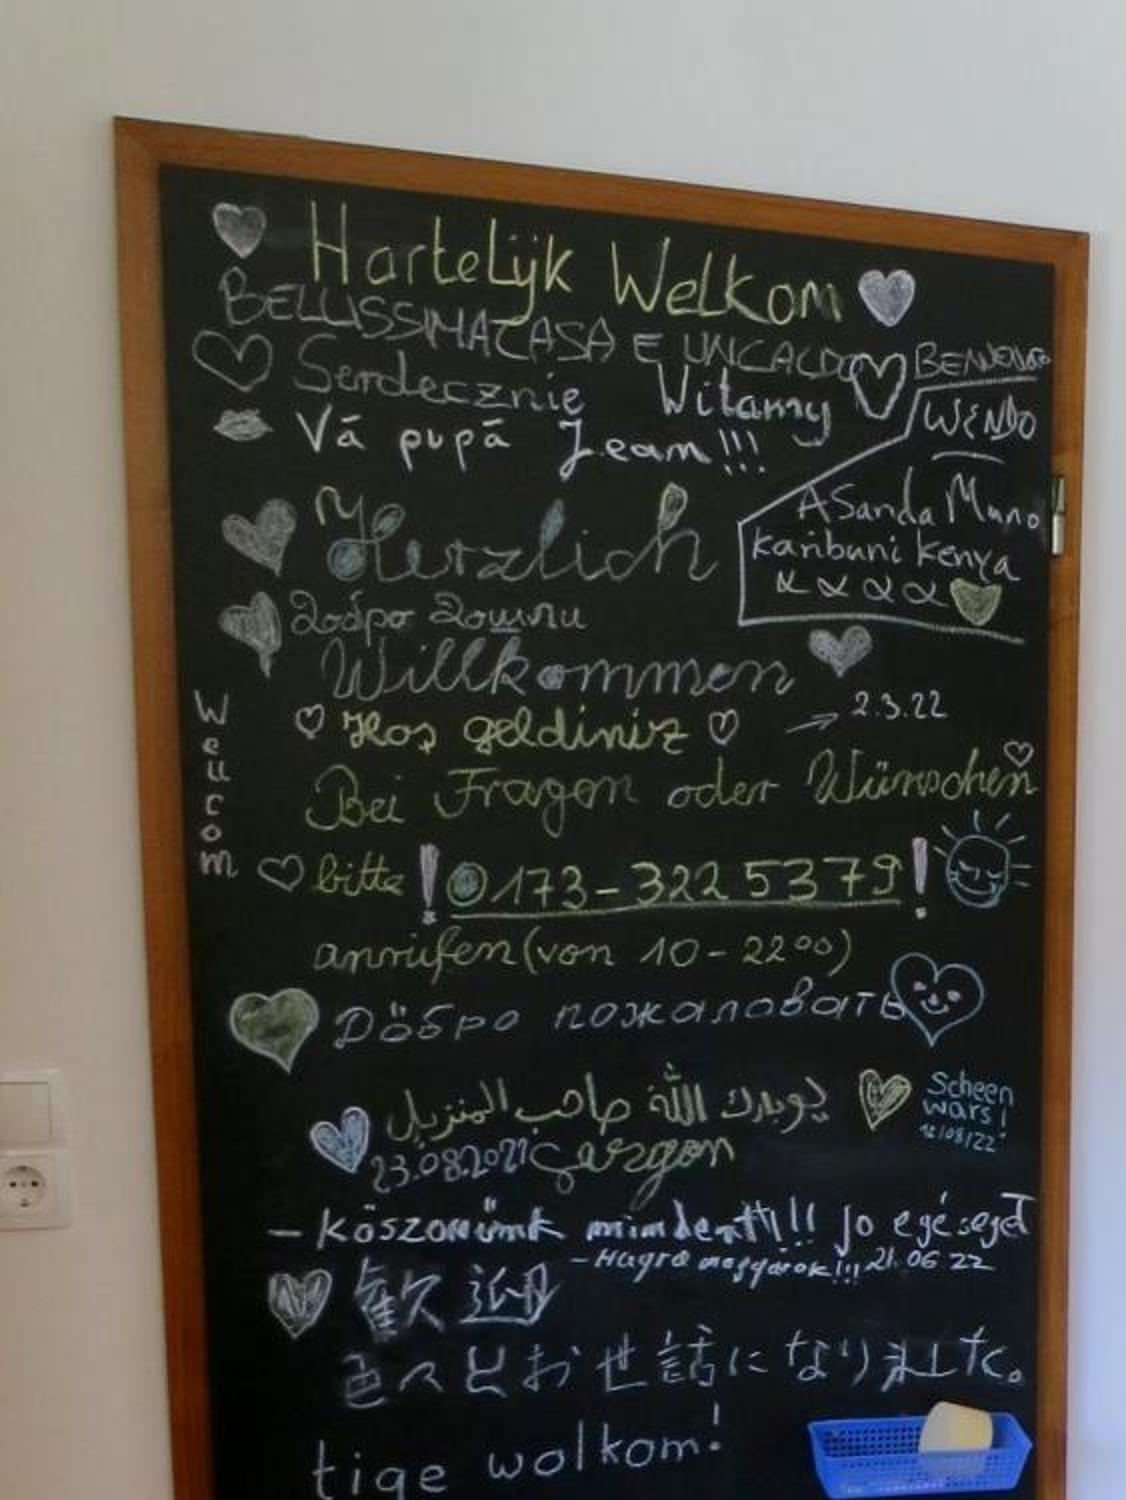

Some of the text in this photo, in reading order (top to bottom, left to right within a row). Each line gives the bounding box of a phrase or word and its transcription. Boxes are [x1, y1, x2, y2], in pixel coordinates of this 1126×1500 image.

[612, 237, 842, 324] Welkom
[657, 364, 832, 448] Witamy
[320, 634, 796, 701] Willkommen
[463, 705, 690, 756] geldiniz
[667, 755, 780, 809] oder
[807, 747, 1039, 806] Wünschen
[488, 1402, 721, 1481] wolkom!
